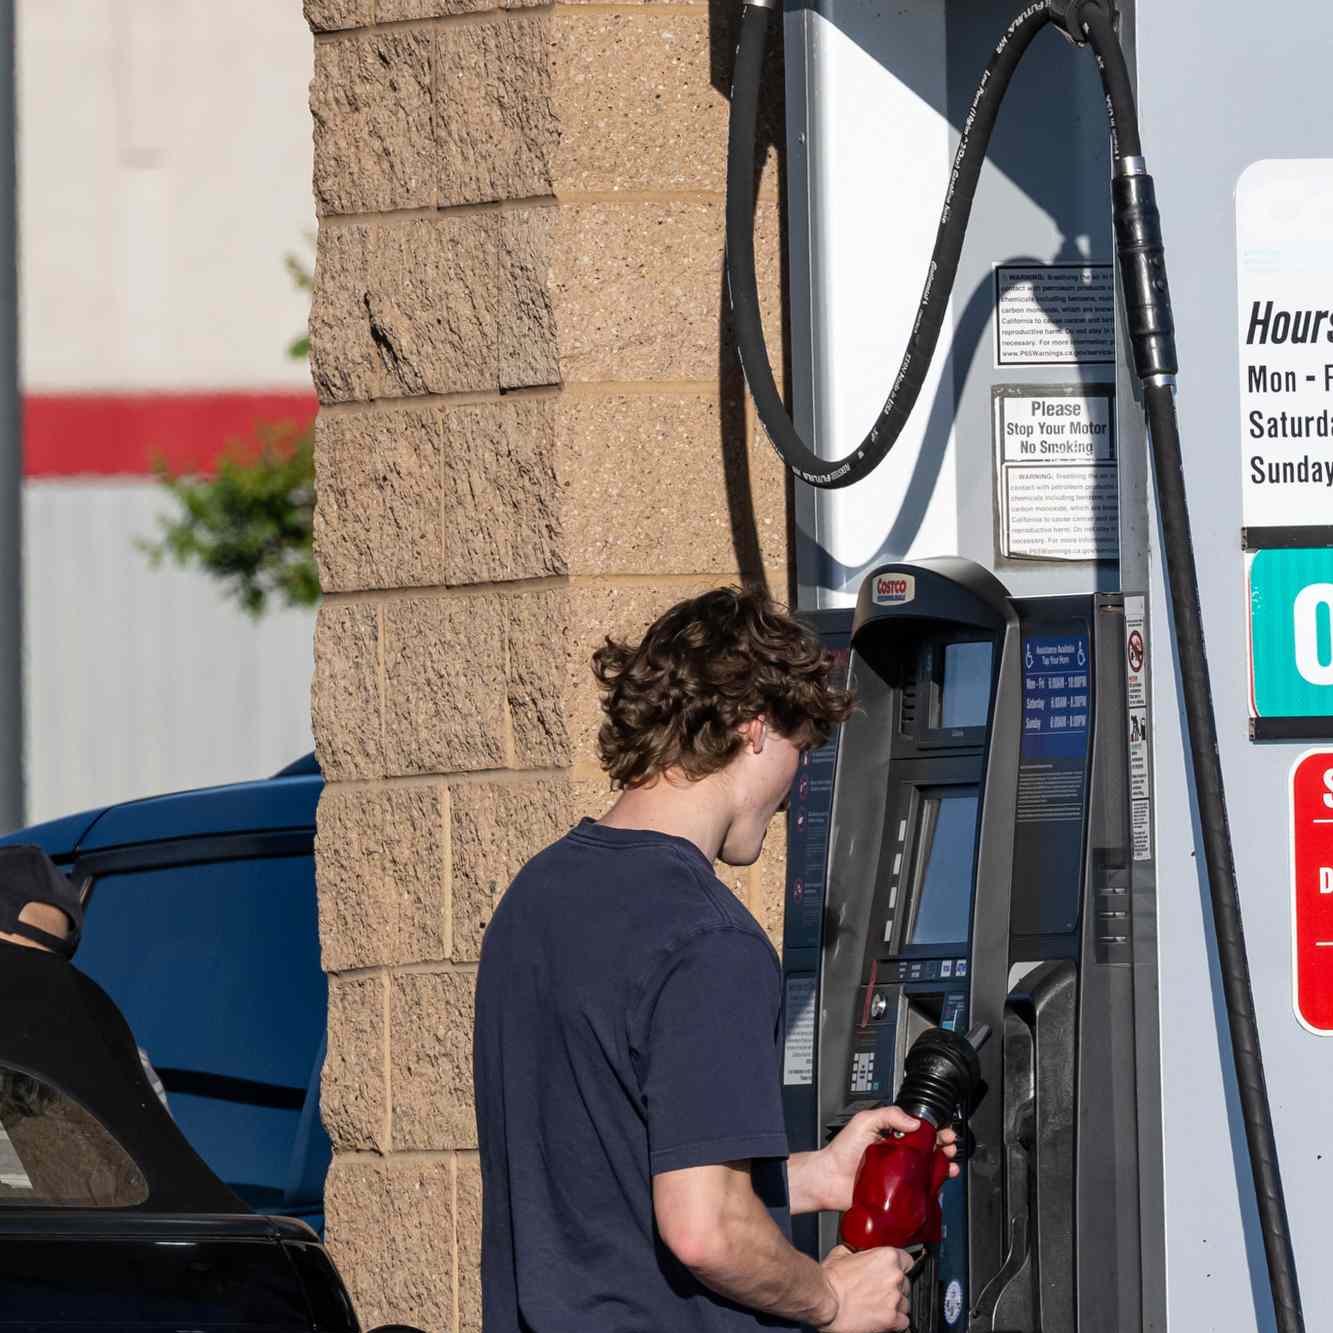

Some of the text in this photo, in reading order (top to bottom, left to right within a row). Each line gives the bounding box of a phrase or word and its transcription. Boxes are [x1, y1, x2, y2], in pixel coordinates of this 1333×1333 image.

[1248, 365, 1296, 393] Mon
[1031, 401, 1081, 417] Please
[1006, 421, 1107, 437] Stop Your Motor
[1020, 440, 1094, 456] No Smoking
[877, 578, 907, 594] COSTCO
